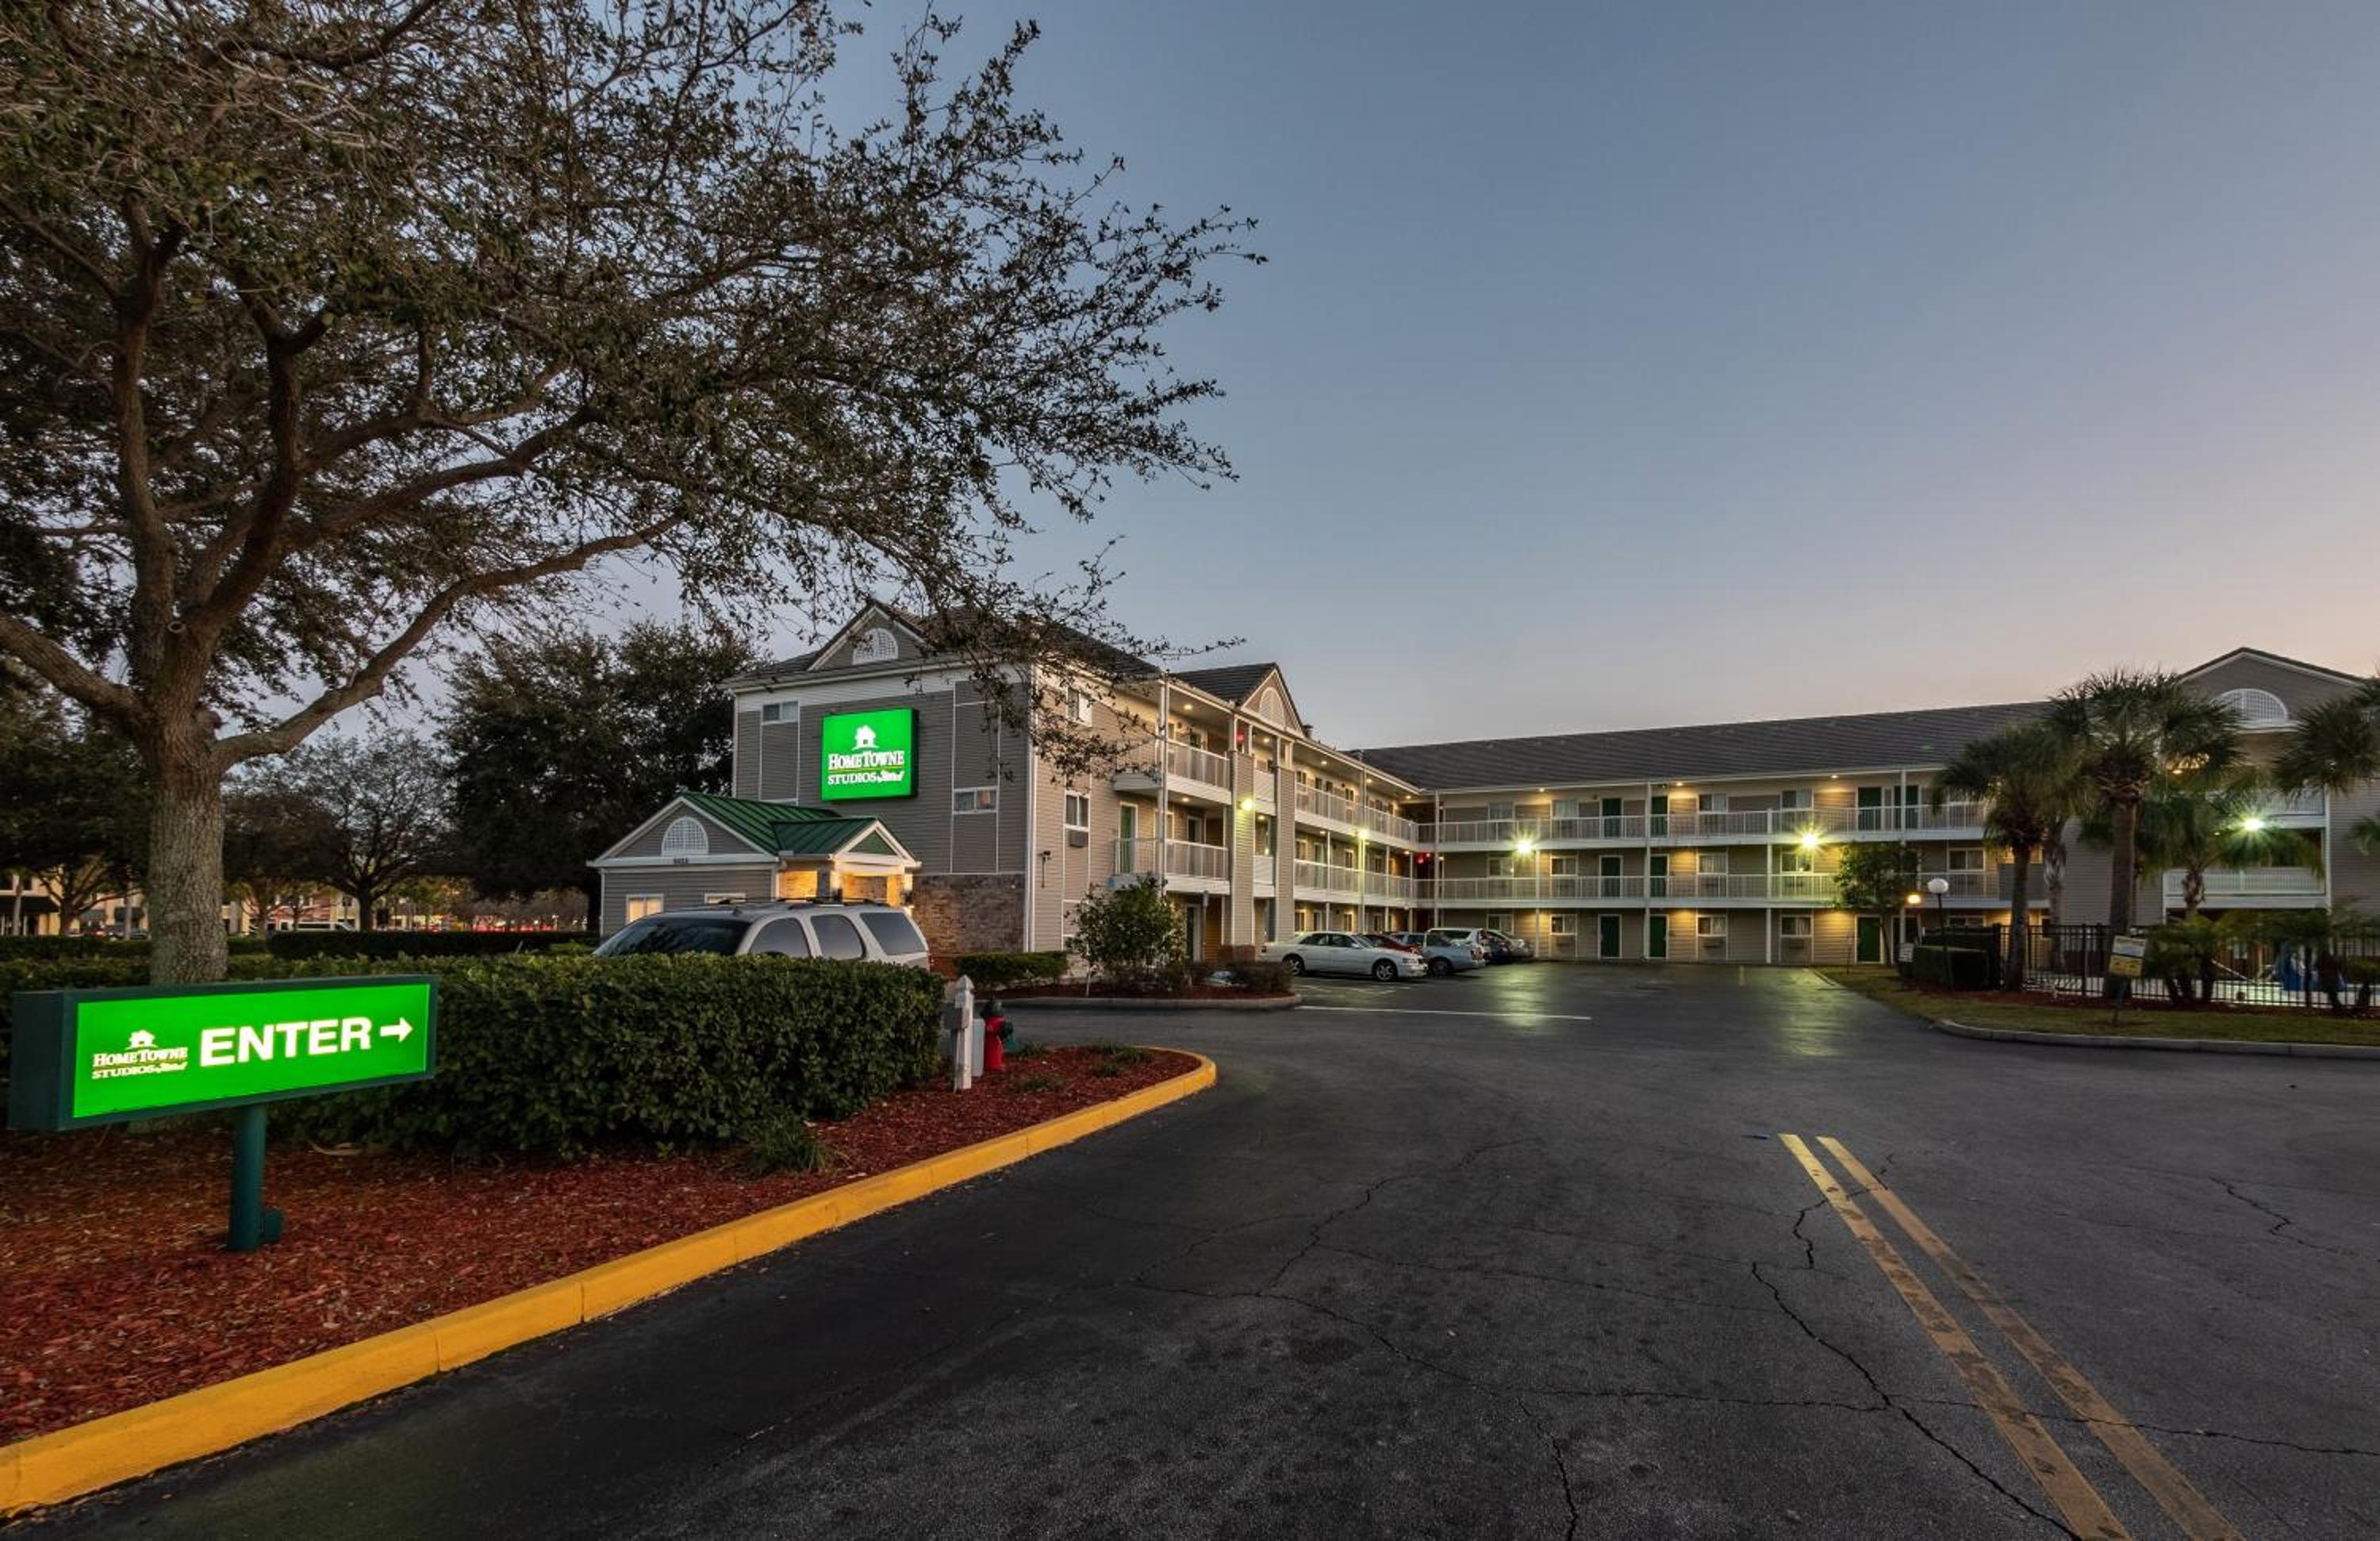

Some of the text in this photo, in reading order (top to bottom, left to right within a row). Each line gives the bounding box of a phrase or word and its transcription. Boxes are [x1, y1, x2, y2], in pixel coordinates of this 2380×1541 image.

[827, 771, 877, 785] STUDIOS
[200, 1016, 372, 1066] ENTER
[91, 1064, 157, 1079] STUDIOS
